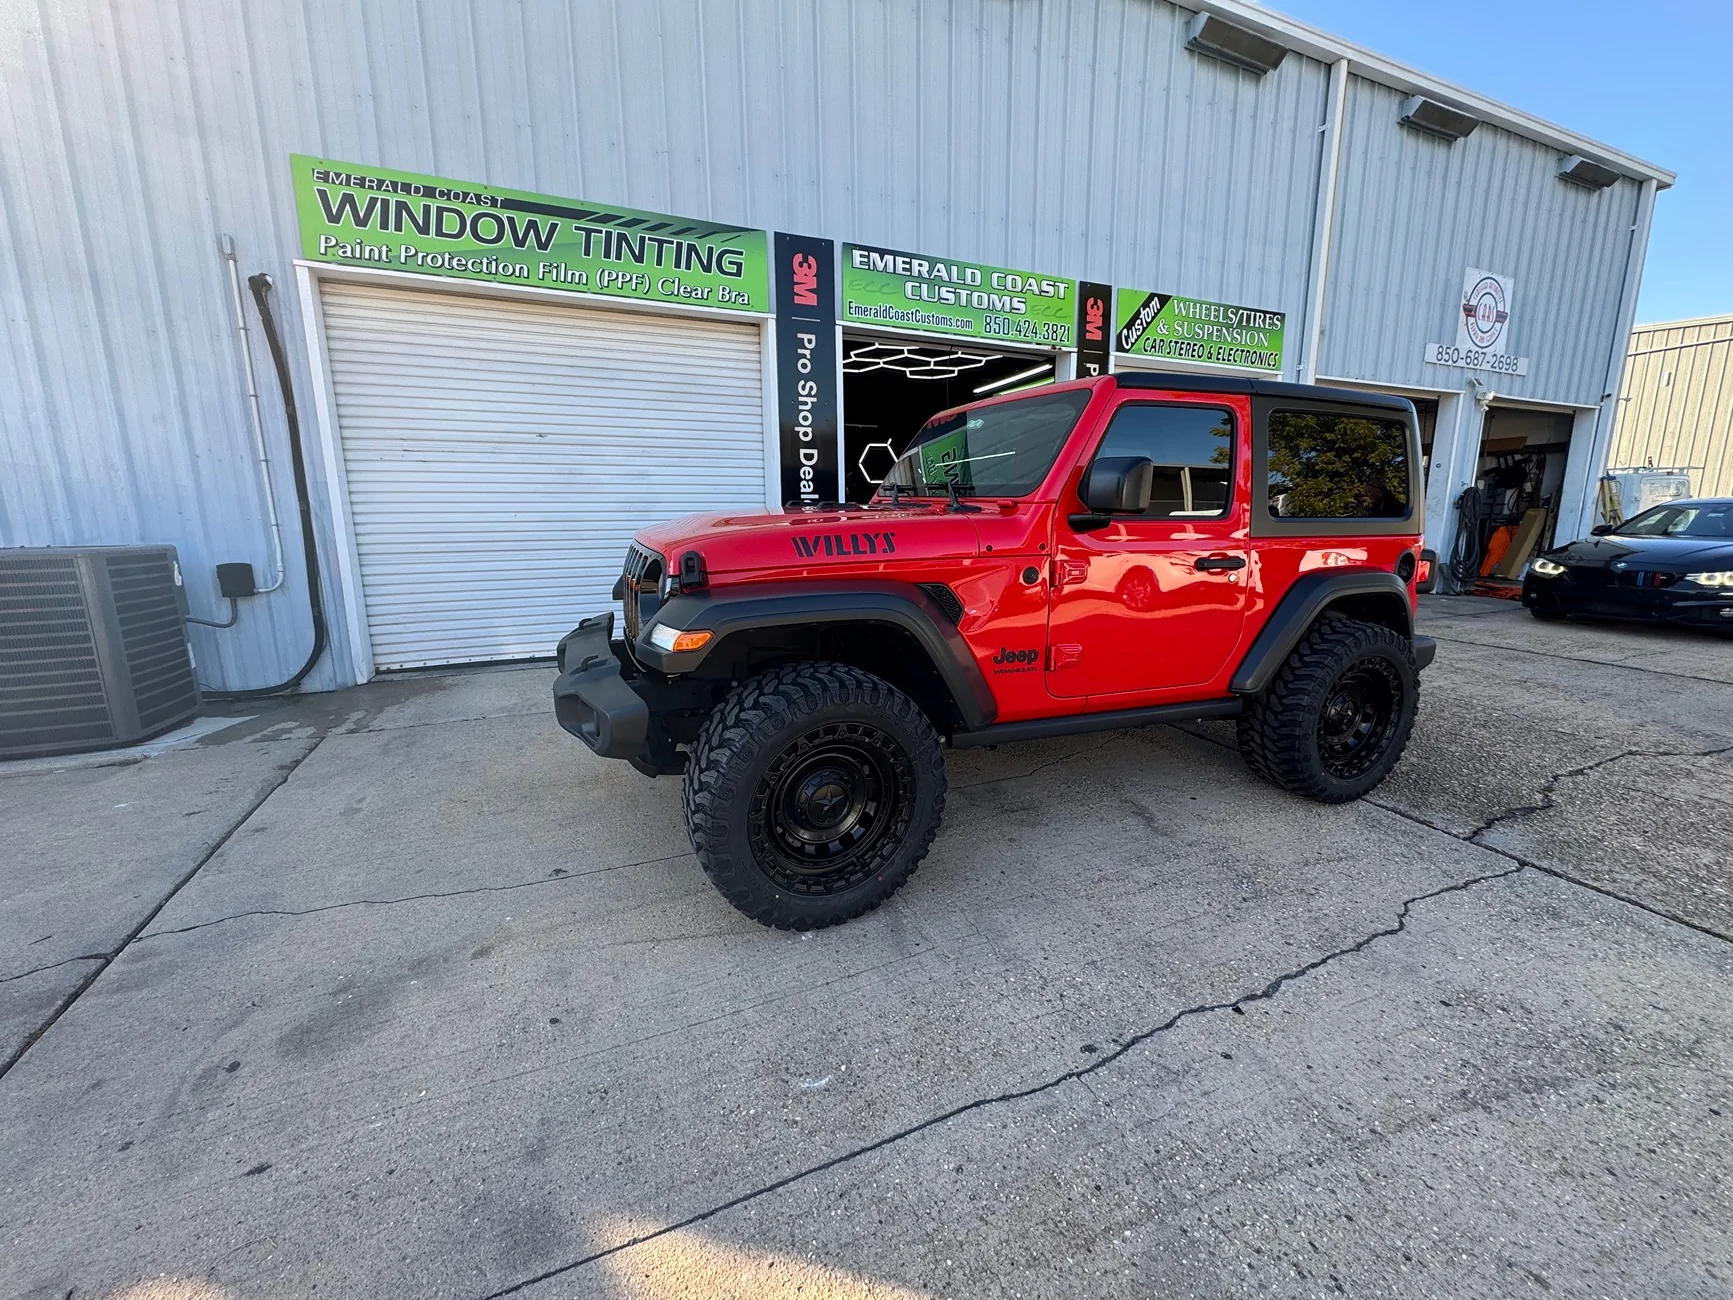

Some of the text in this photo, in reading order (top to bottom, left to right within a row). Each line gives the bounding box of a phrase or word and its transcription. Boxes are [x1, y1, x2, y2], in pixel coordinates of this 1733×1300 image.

[312, 168, 505, 208] EMERALD COAST
[314, 188, 745, 280] WINDOW TINTING
[319, 234, 750, 306] Paint Protection Film (PPF) Clear Bra
[851, 249, 1069, 300] EMERALD COAST
[904, 281, 1027, 315] CUSTOMS
[1172, 299, 1282, 331] WHEELS/TIRES
[847, 300, 1071, 344] EmeraldCoastCustoms.com 850.424.3821
[1085, 297, 1104, 341] 3M
[1121, 296, 1161, 350] Custom
[1157, 319, 1270, 348] & SUSPENSION
[1142, 336, 1278, 368] CAR STEREO & ELECTRONICS
[1436, 345, 1519, 372] 850-687-2698
[792, 253, 819, 502] 3M Pro Shop Deal
[790, 531, 897, 558] WILLYS
[993, 647, 1039, 665] Jeep
[993, 667, 1037, 675] WRANGLER
